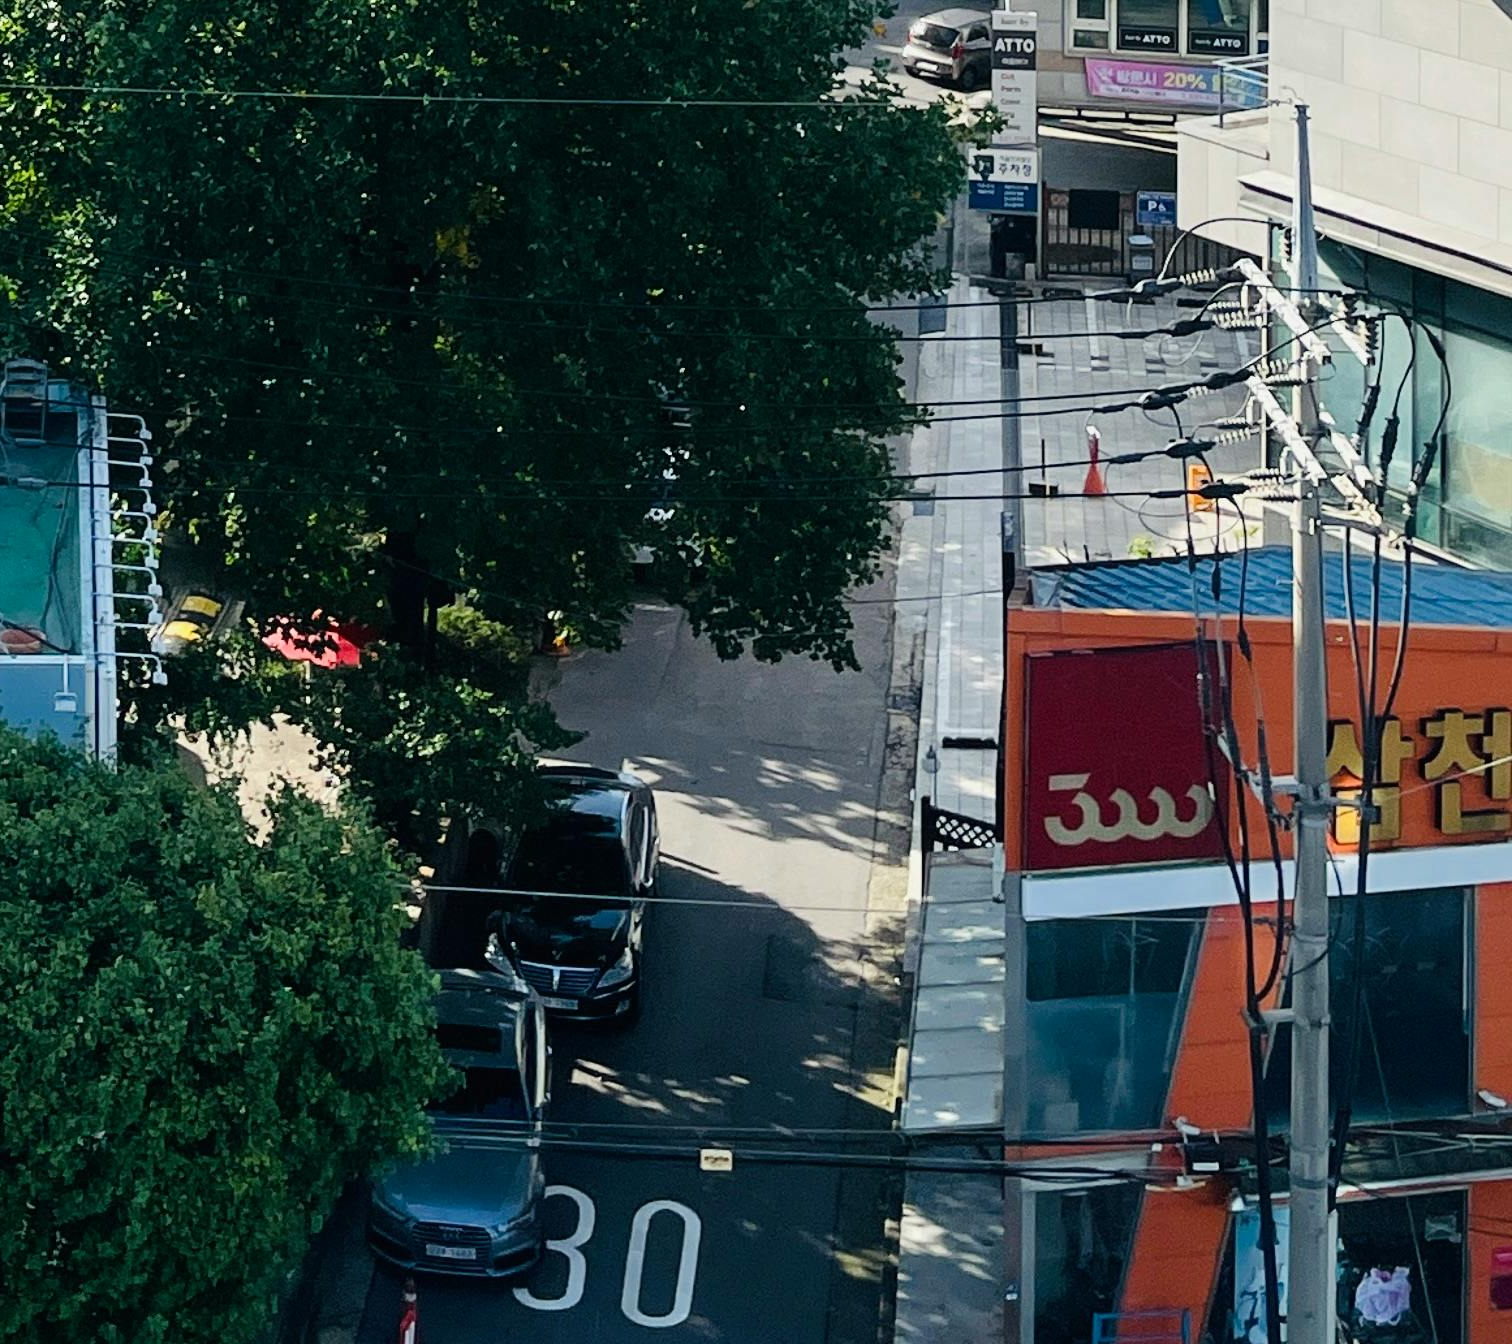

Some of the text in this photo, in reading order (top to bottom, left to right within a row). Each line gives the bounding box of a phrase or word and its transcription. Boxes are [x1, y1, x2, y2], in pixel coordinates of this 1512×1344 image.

[994, 37, 1036, 54] ATTO
[1142, 34, 1171, 45] ATTO
[1213, 38, 1242, 49] ATTO
[1163, 71, 1207, 90] 20%
[512, 1184, 702, 1328] 30
